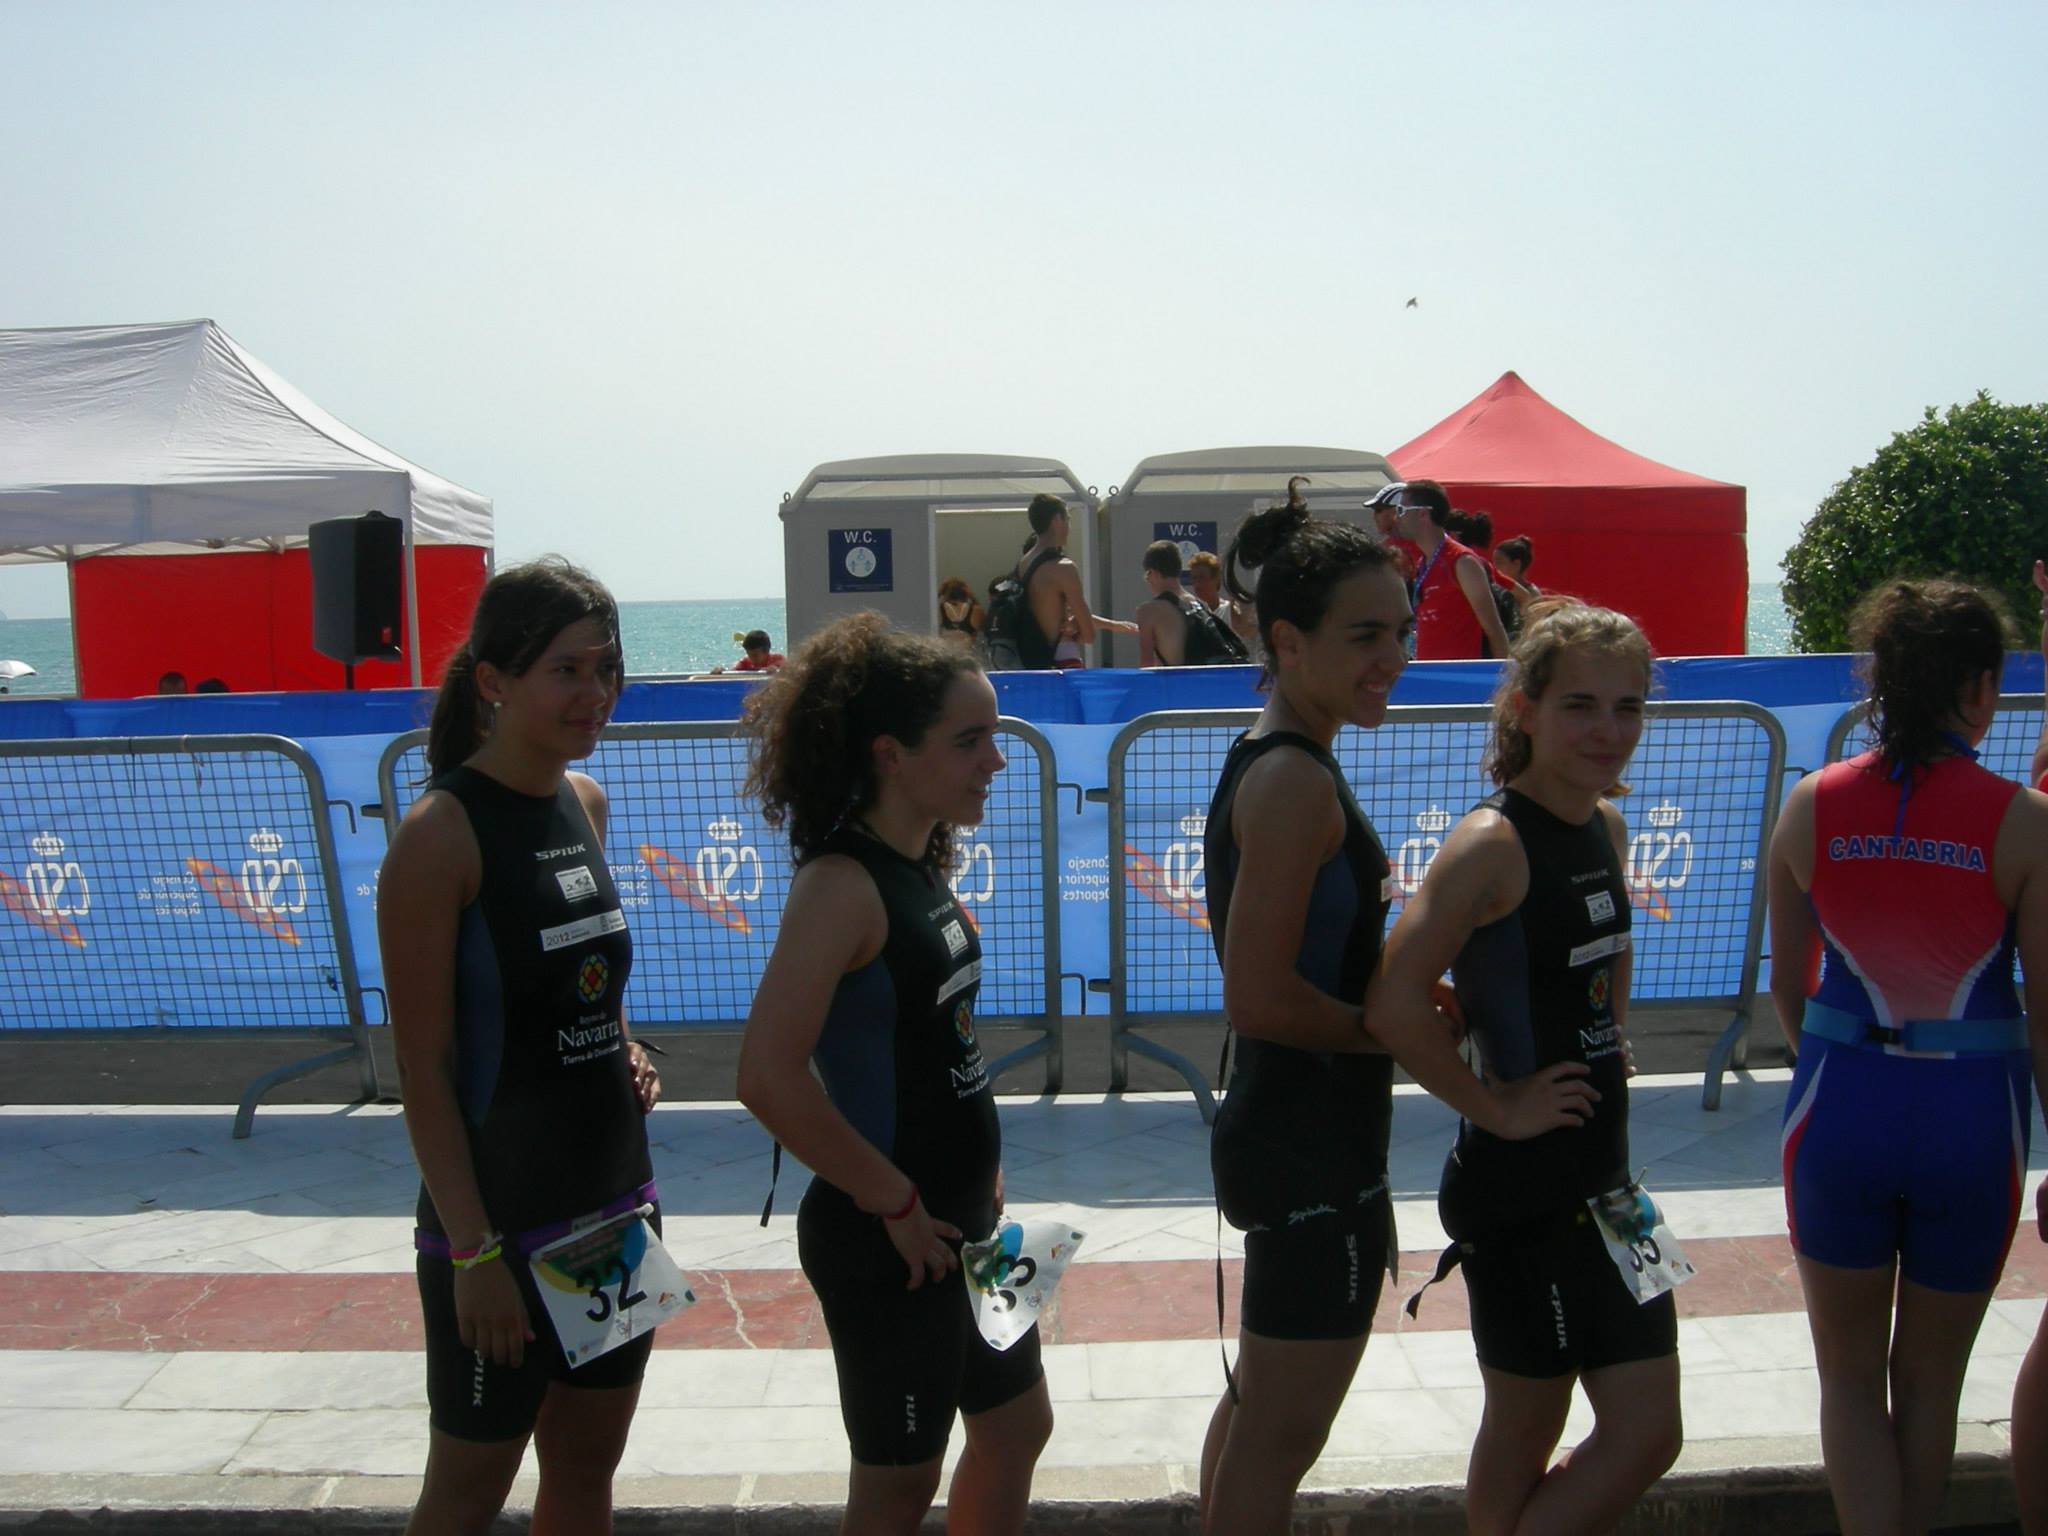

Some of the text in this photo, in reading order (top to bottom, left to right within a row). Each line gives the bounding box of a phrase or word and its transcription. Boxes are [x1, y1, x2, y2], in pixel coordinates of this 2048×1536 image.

[843, 530, 878, 544] W.C.
[1169, 523, 1203, 537] W.C.
[535, 843, 587, 861] SPIUK
[1828, 835, 1986, 872] CANTABRIA
[575, 1257, 648, 1323] 32
[472, 1346, 486, 1408] PIUK
